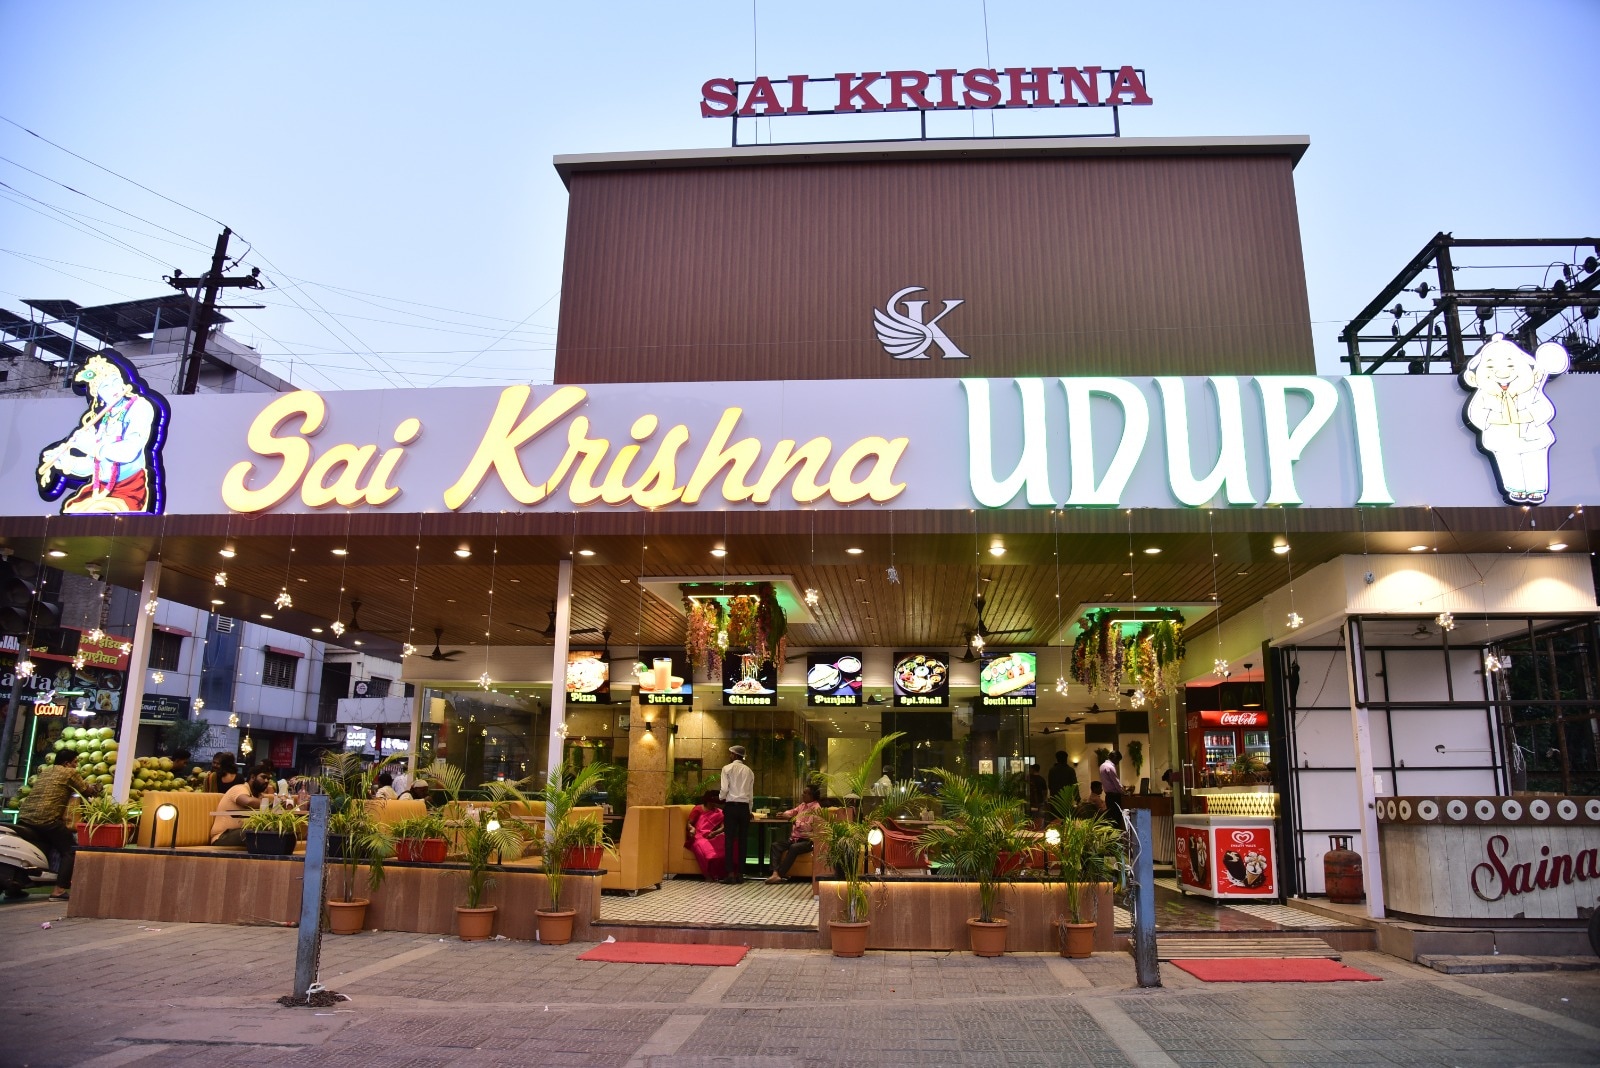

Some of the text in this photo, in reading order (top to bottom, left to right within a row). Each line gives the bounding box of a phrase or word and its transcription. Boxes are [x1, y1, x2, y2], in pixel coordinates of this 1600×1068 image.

[700, 66, 1153, 118] SAI KRISHNA
[221, 375, 1395, 513] Sai Krishna UDUPI
[571, 692, 597, 703] Pizza
[648, 693, 684, 704] Juices
[728, 695, 771, 705] Chinese
[815, 695, 856, 705] Punjabi
[983, 697, 1033, 706] South Indian
[157, 704, 177, 713] Gallery
[1220, 712, 1258, 725] Coca-Cola
[346, 732, 367, 740] CAKE
[1471, 835, 1600, 902] Saina
